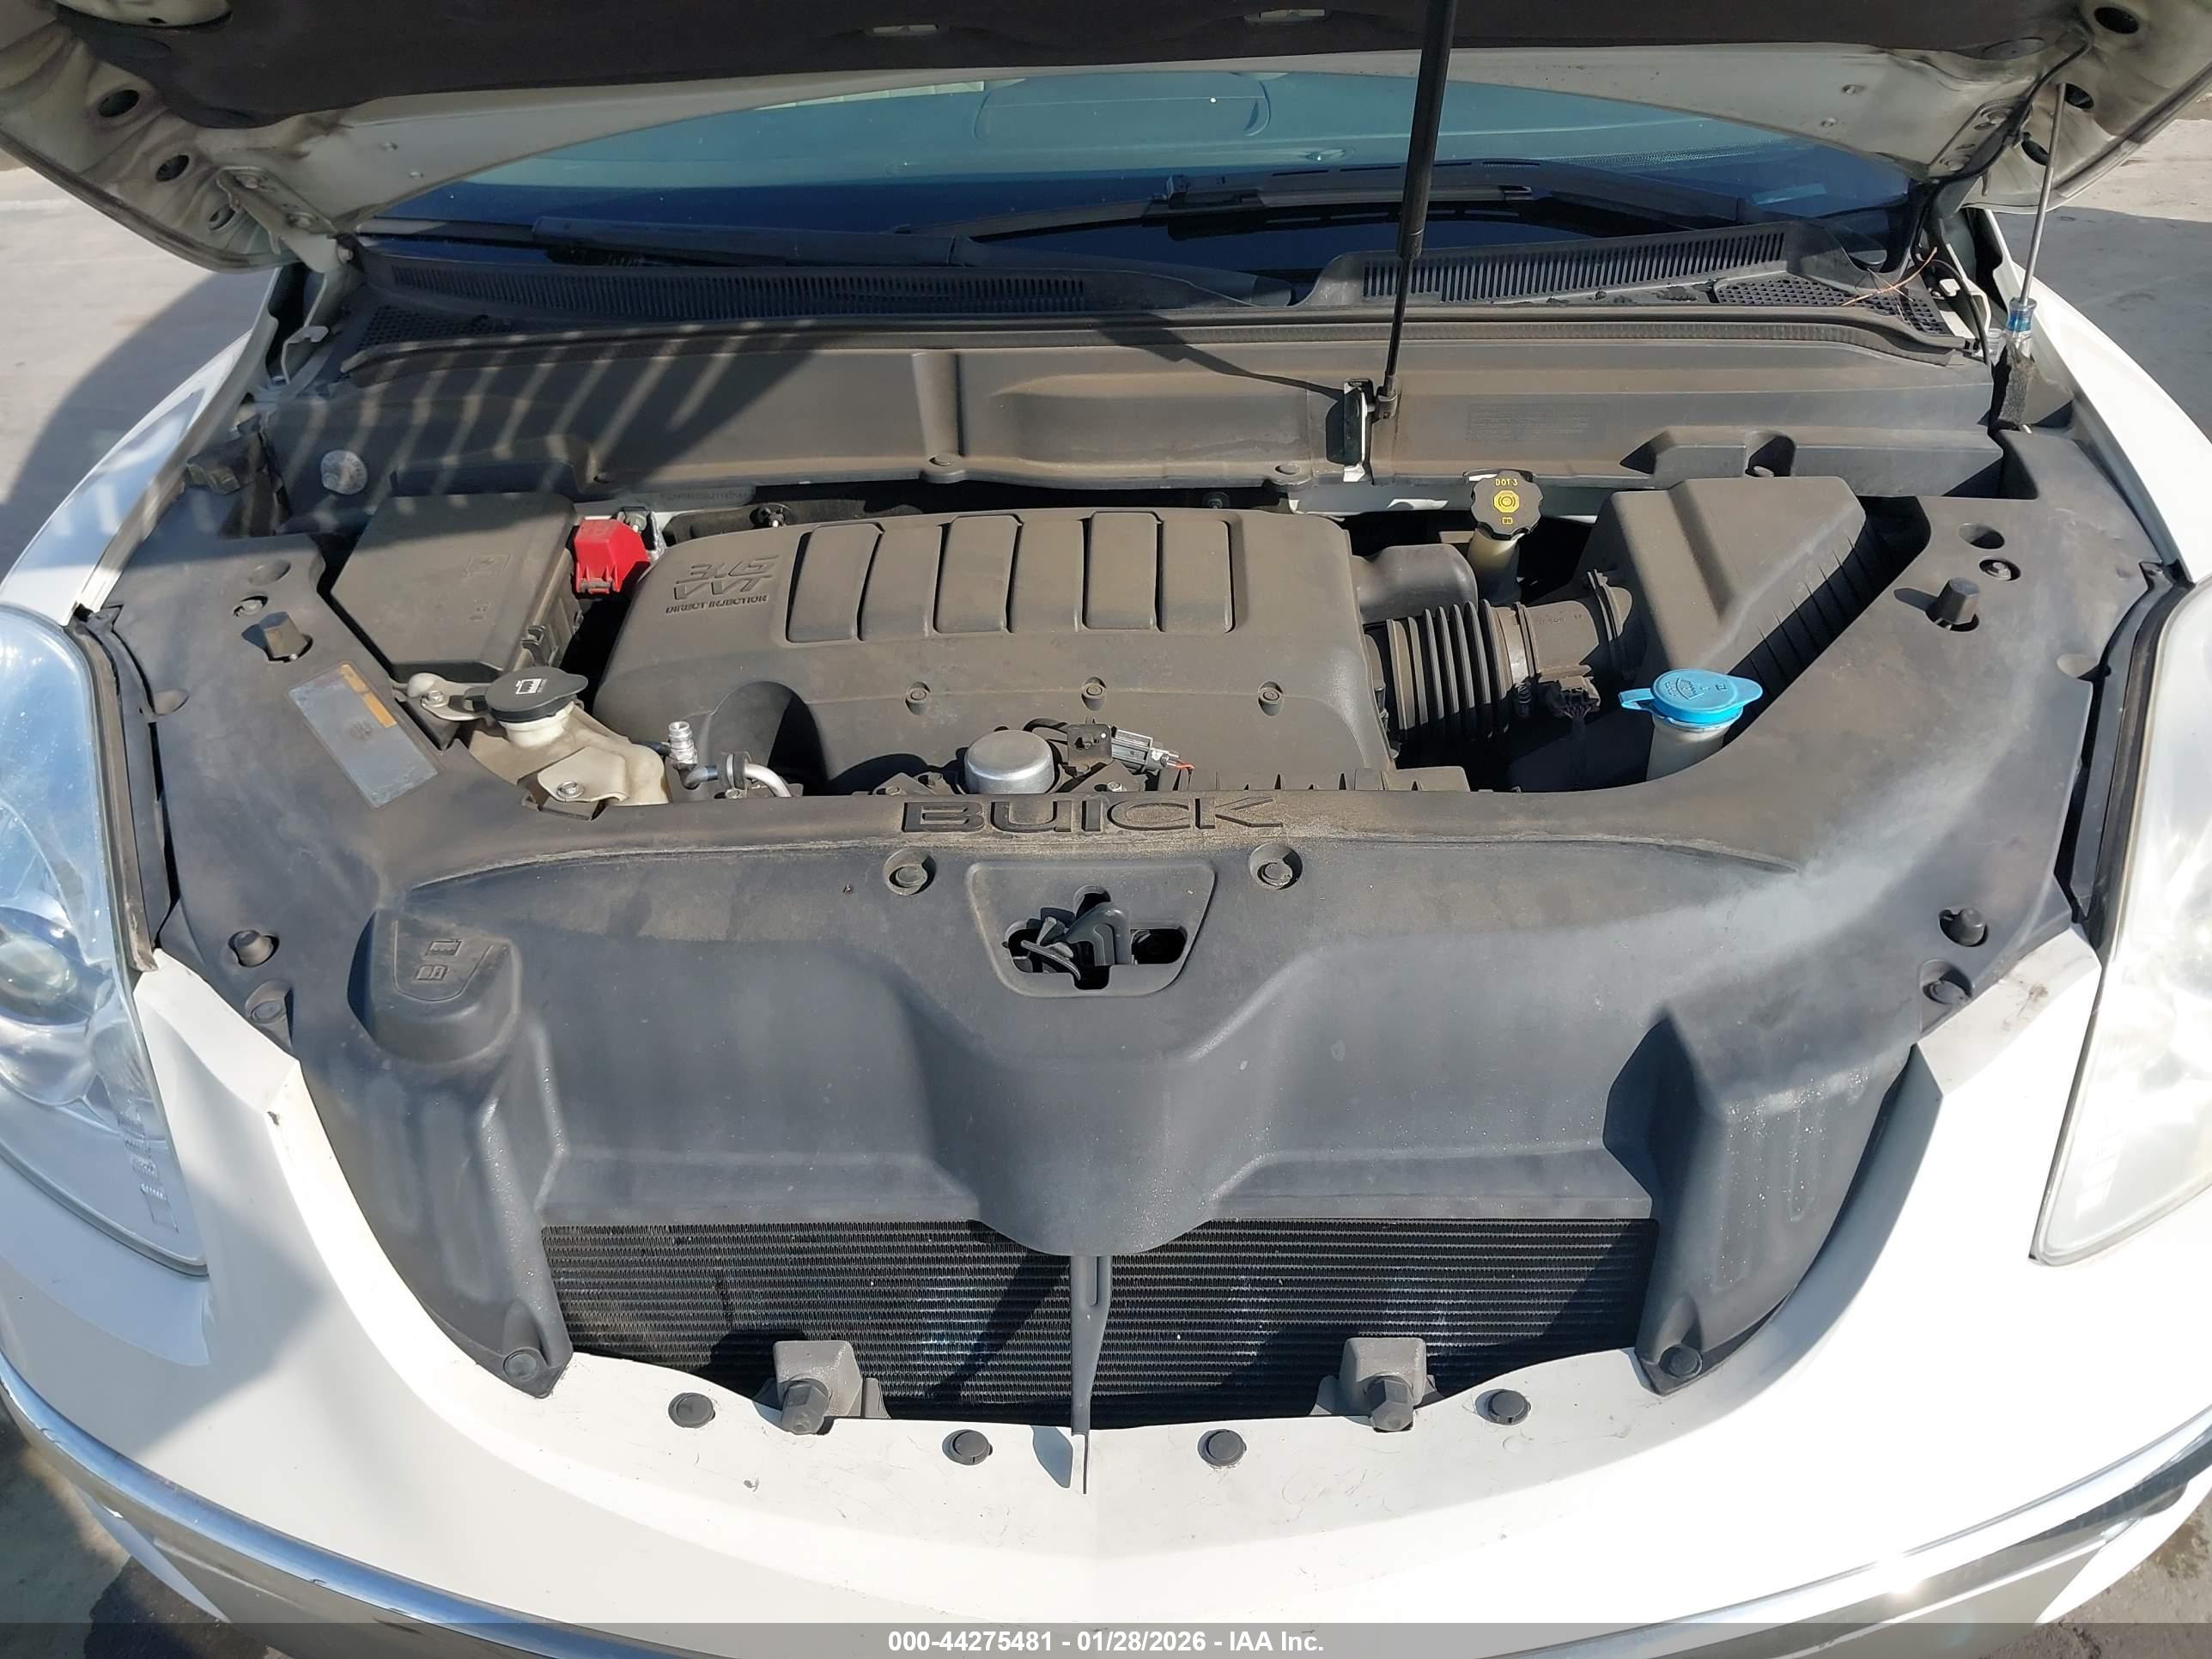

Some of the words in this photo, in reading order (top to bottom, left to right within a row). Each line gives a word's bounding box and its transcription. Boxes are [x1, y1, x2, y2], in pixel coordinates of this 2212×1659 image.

[673, 574, 773, 600] VVT
[665, 600, 708, 614] DIRECT
[708, 594, 769, 608] INJECTION
[902, 796, 1284, 833] BUICK
